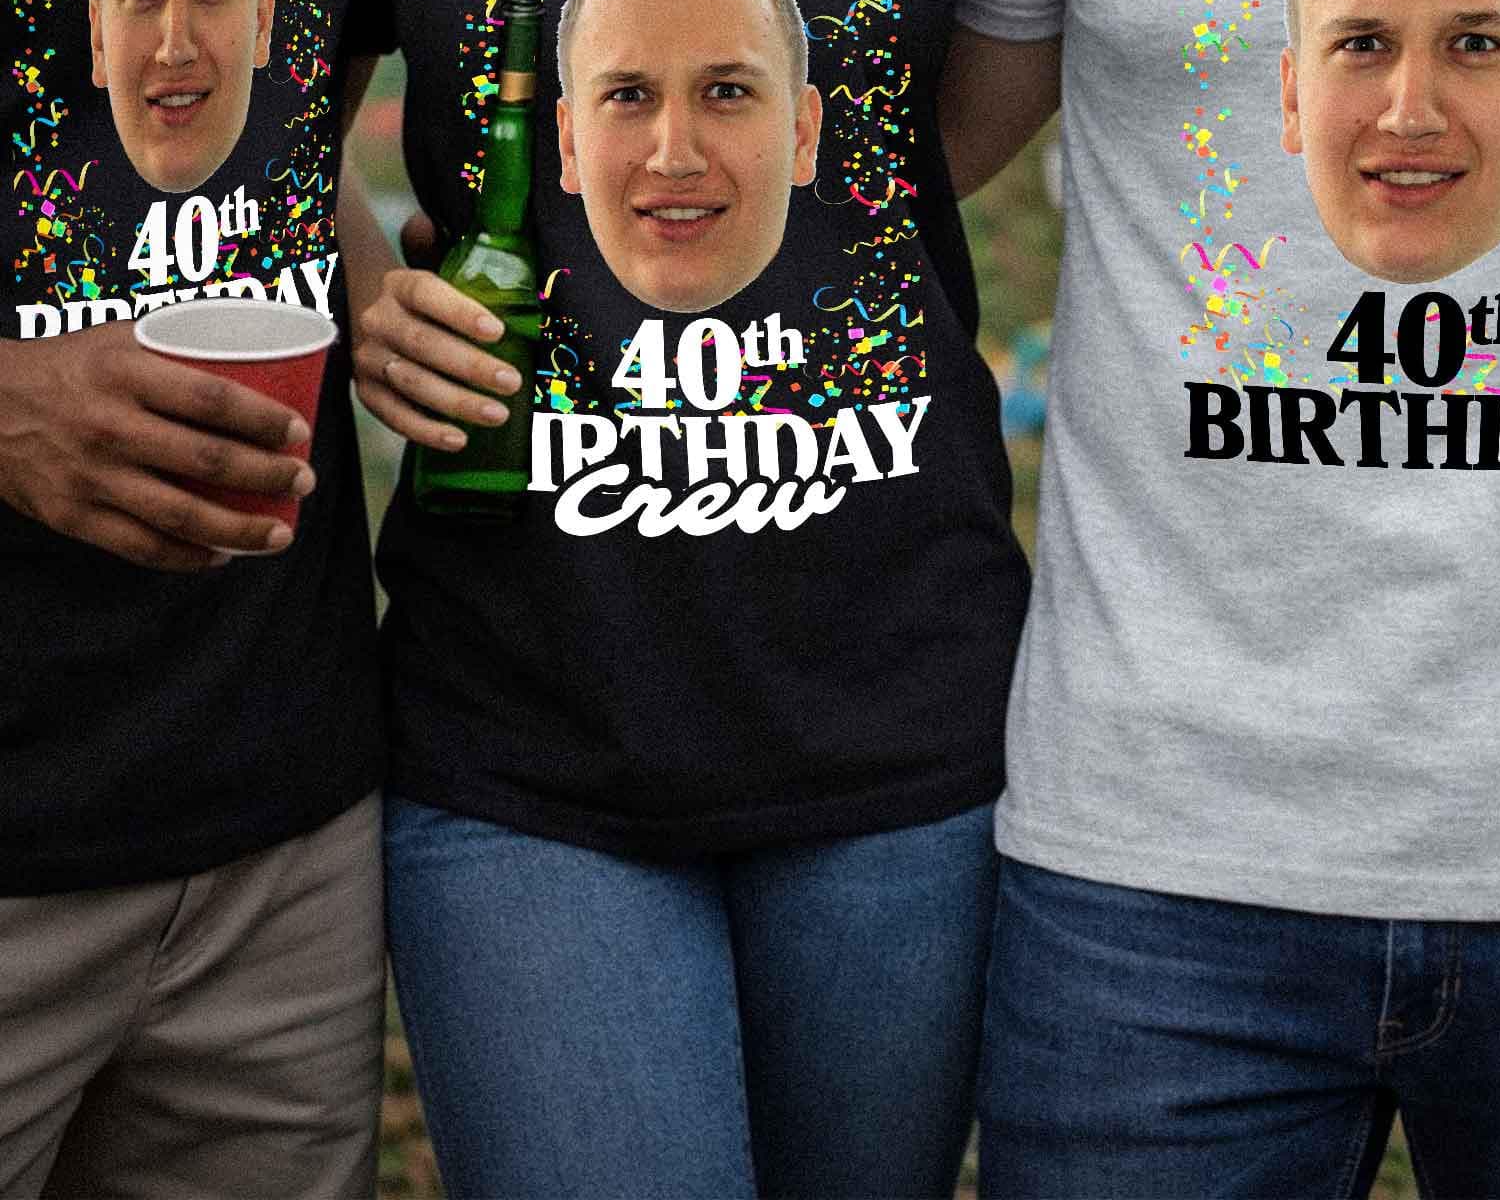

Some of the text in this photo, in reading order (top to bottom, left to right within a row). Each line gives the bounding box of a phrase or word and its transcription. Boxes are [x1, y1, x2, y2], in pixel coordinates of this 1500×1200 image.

[127, 186, 262, 288] 40th
[612, 313, 808, 411] 40th
[527, 396, 932, 493] IRTHDAY
[555, 463, 847, 538] Crew
